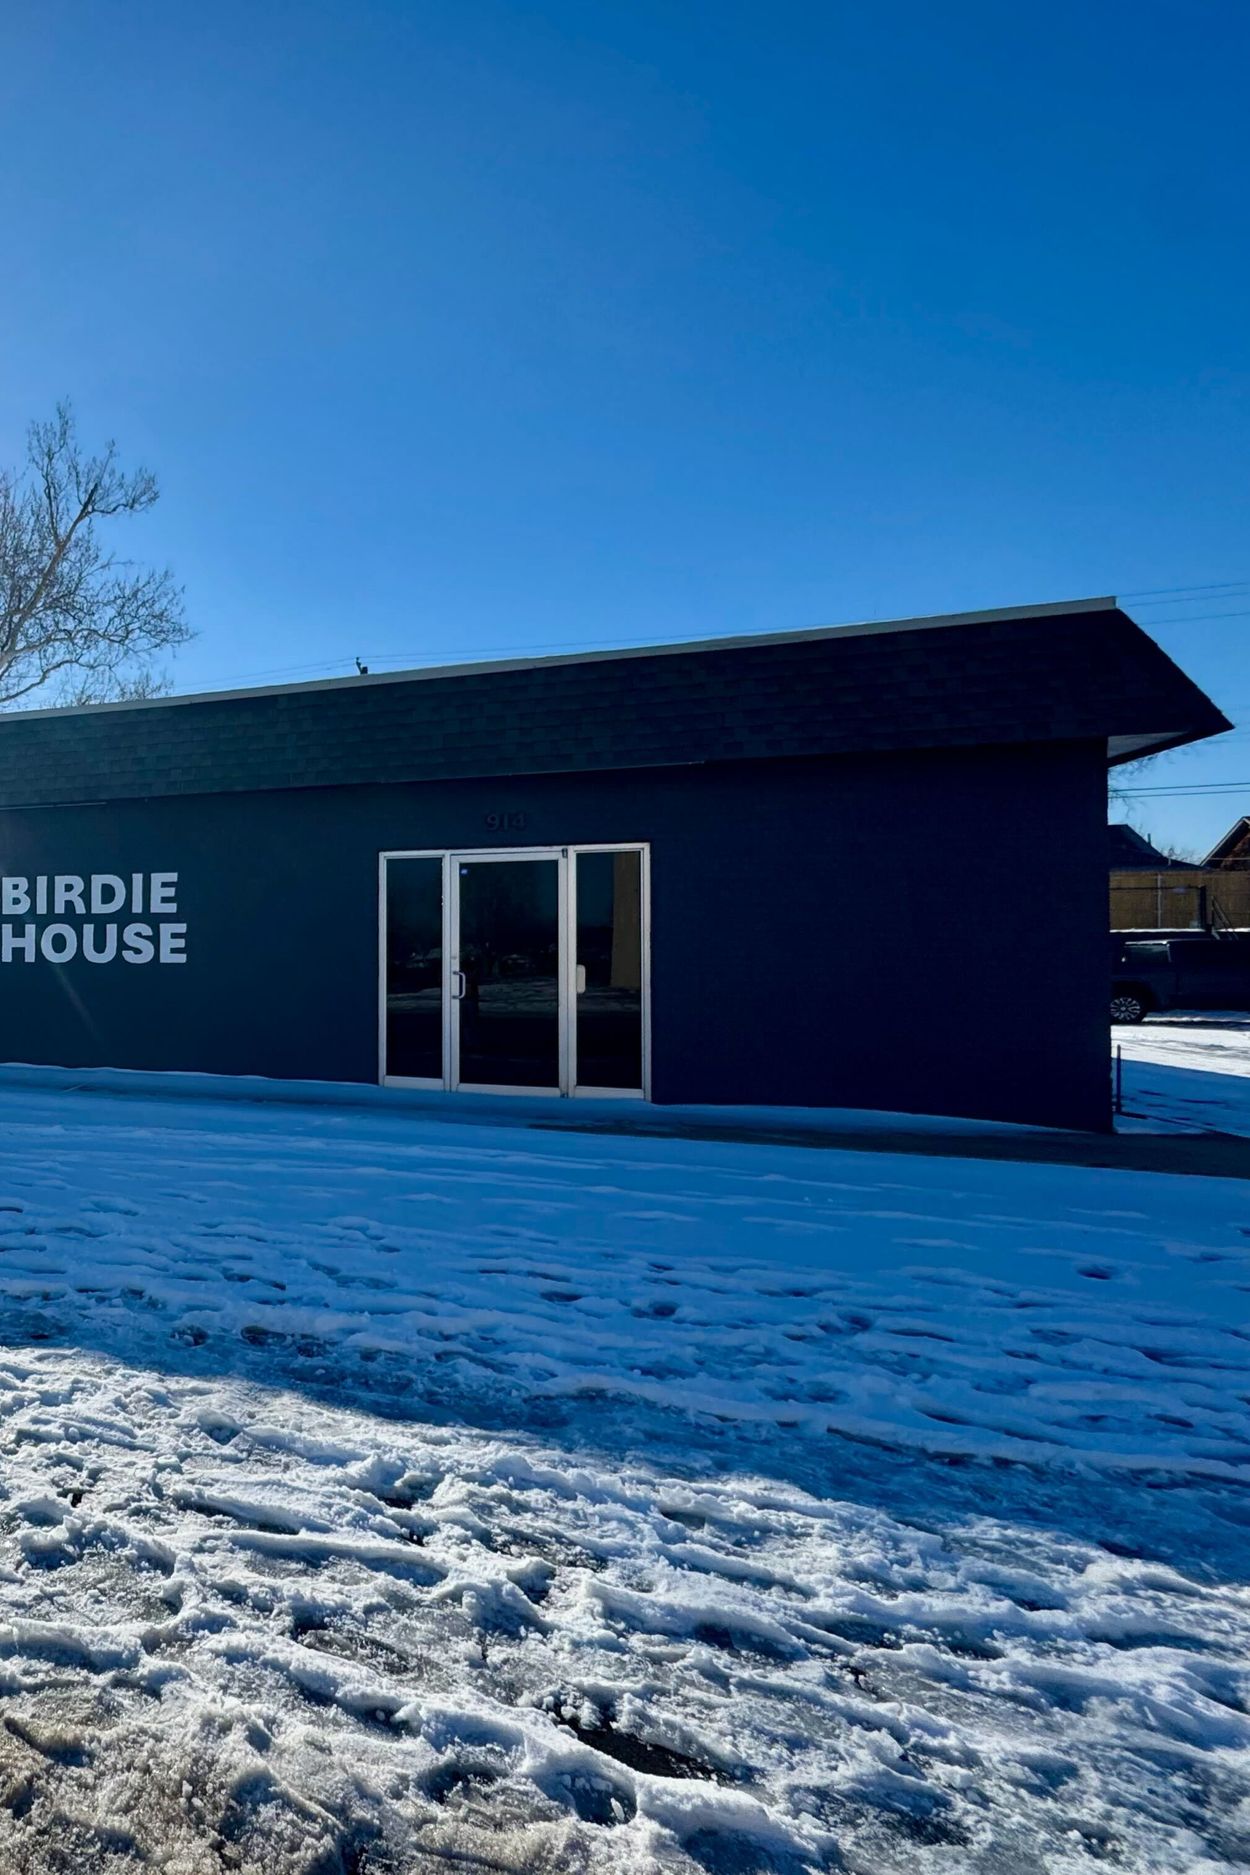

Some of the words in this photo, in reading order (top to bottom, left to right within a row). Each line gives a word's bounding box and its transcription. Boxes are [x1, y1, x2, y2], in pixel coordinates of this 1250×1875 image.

[487, 813, 524, 830] 914
[2, 872, 179, 914] BIRDIE
[1, 922, 187, 964] HOUSE
